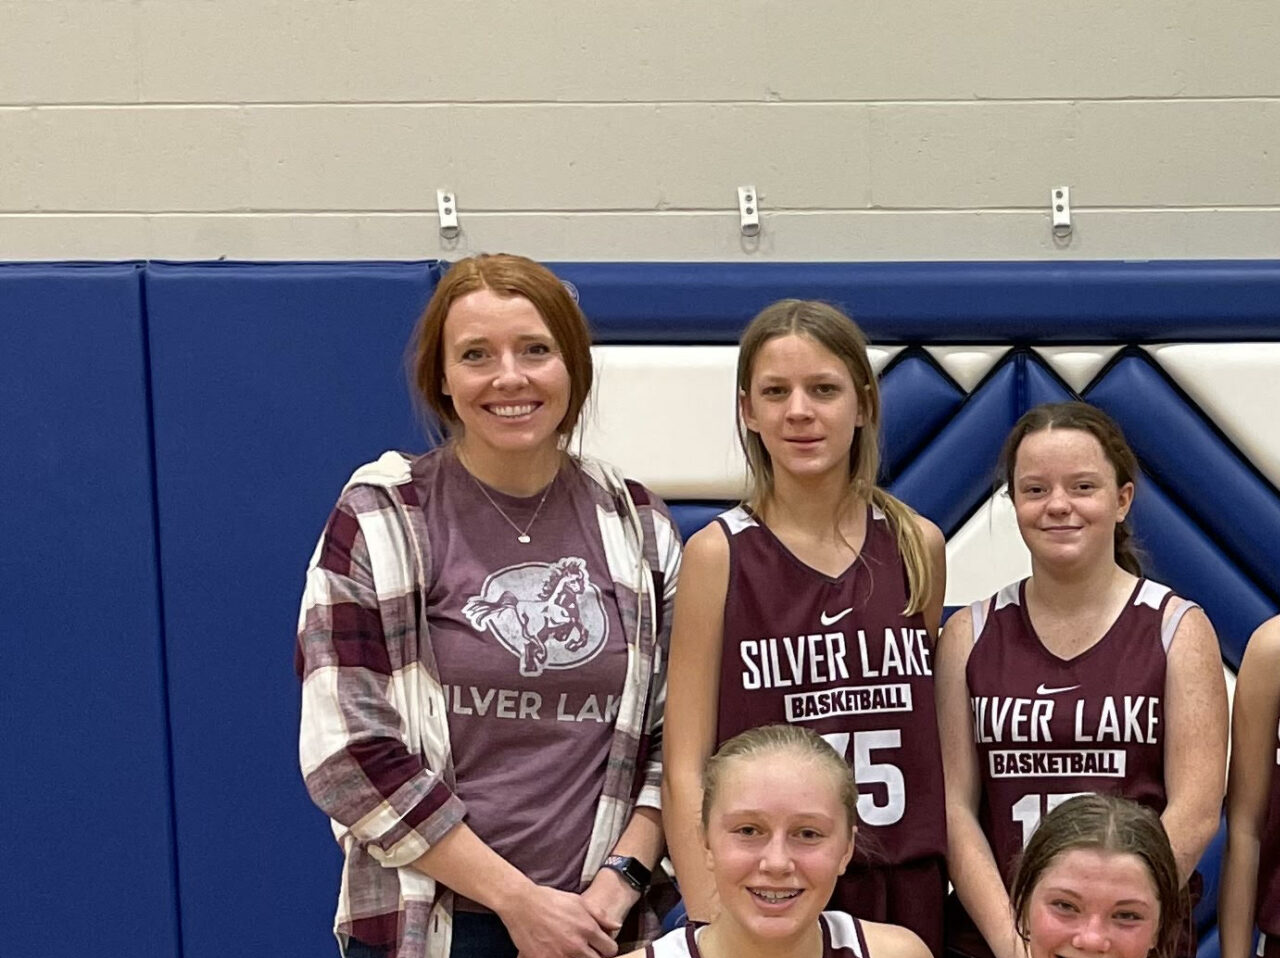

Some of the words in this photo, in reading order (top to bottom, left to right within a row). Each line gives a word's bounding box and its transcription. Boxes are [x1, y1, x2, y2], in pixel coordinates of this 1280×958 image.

[740, 632, 849, 690] SILVER
[861, 628, 932, 678] LAKE
[443, 684, 541, 720] ILVER
[557, 692, 624, 723] LAK
[792, 687, 907, 718] BASKETBALL
[1074, 696, 1160, 744] LAKE
[820, 729, 906, 826] 5
[993, 752, 1119, 775] BASKETBALL
[1011, 791, 1098, 851] 1
